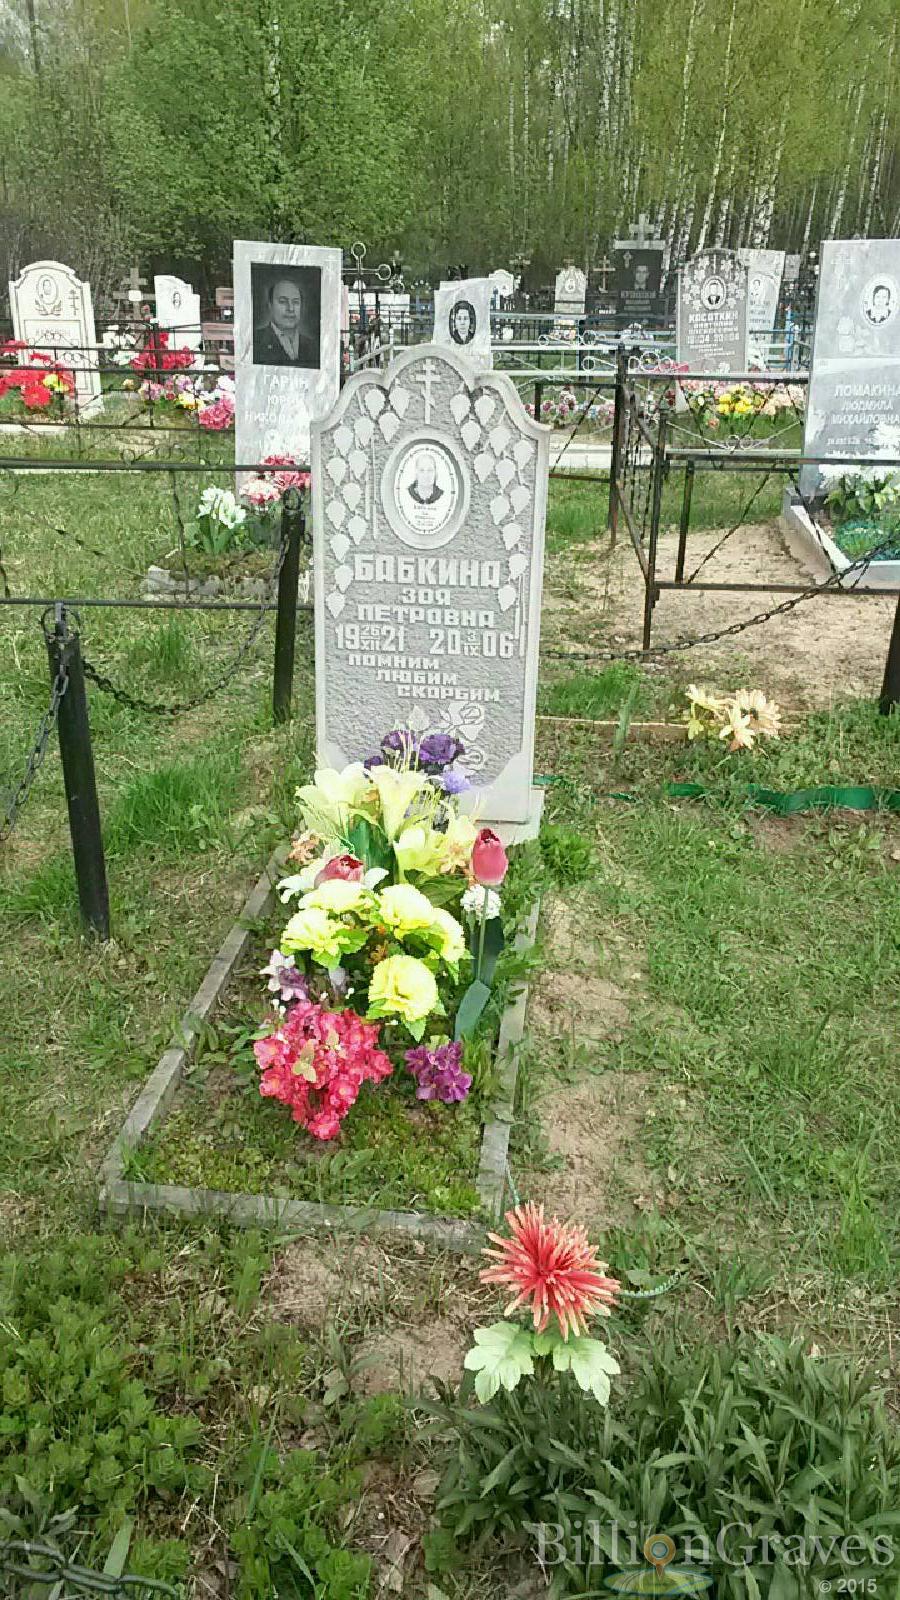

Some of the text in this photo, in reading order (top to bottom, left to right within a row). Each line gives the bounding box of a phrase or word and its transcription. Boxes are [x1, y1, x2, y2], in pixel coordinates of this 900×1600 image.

[354, 554, 500, 588] БАБКИНА
[402, 588, 450, 605] ЗОЯ
[358, 604, 494, 627] ПЕТРОВНА
[349, 655, 439, 670] ПОМНИМ
[376, 669, 459, 686] ЛЮБИМ
[398, 685, 500, 701] СКОРБИМ
